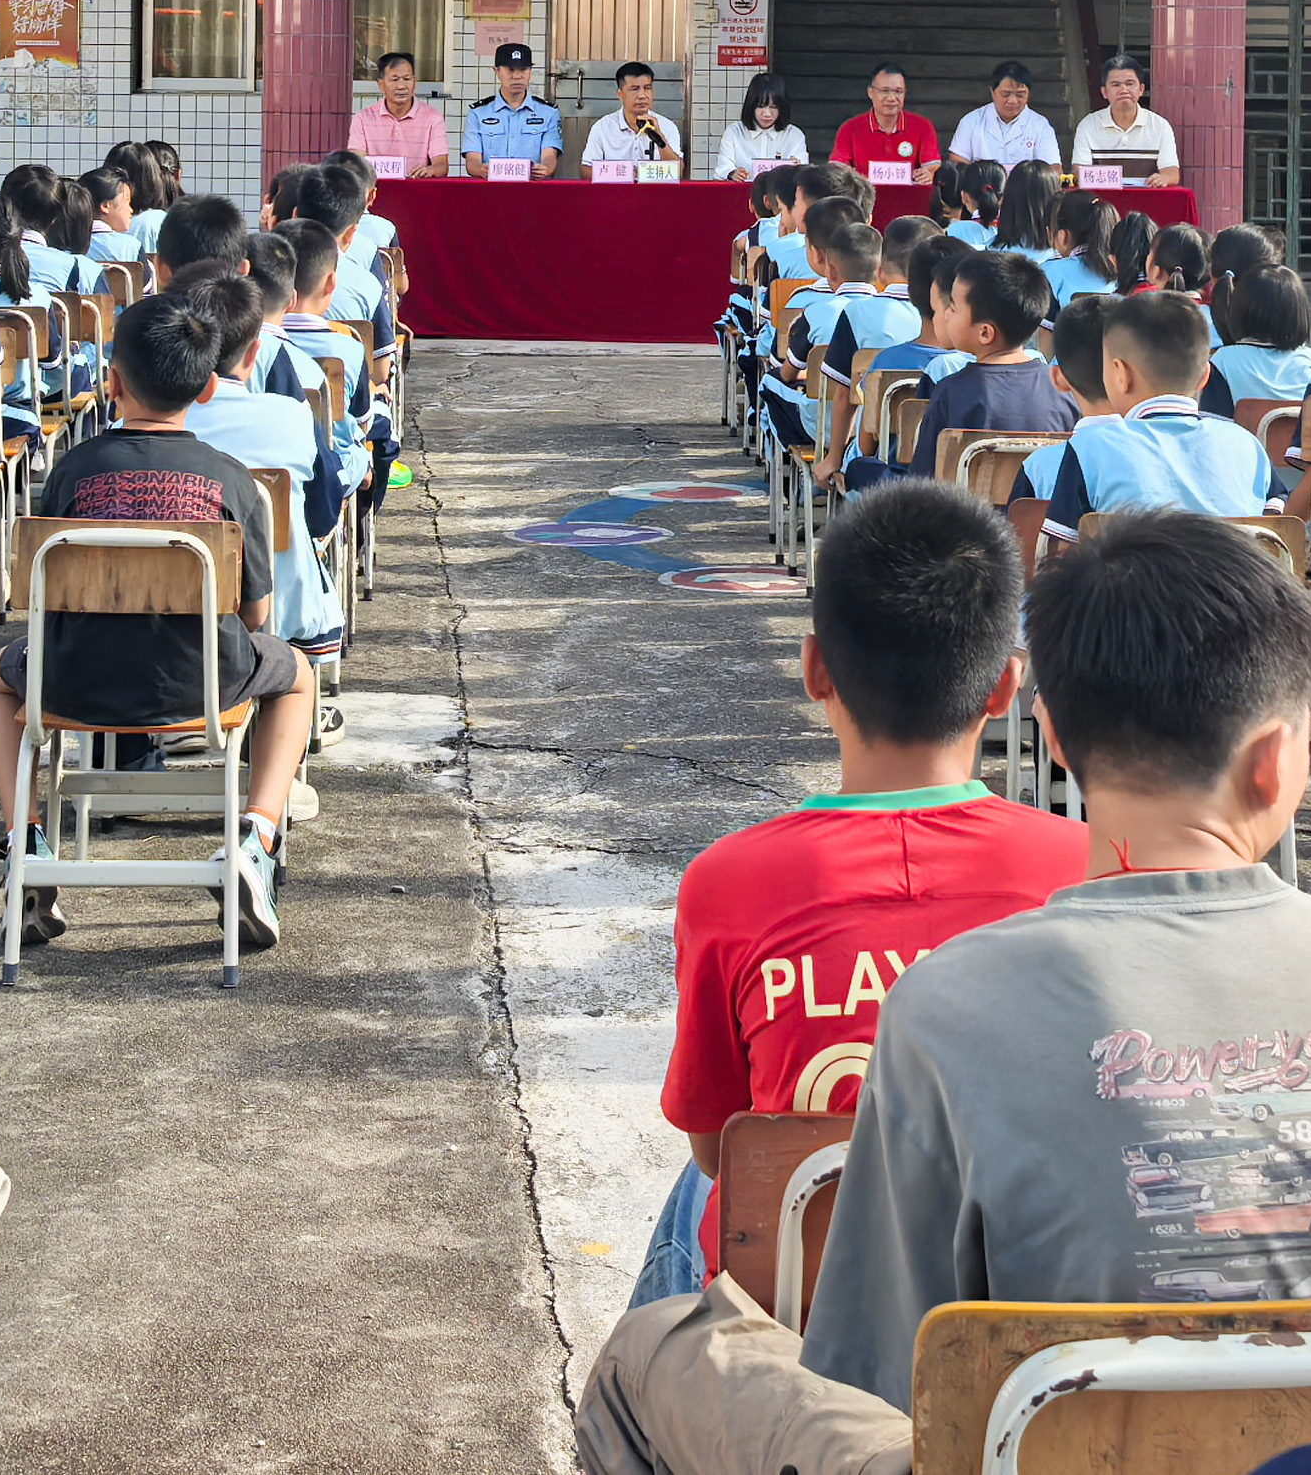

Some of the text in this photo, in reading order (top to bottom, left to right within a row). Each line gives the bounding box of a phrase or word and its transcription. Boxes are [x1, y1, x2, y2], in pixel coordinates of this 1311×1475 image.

[645, 165, 674, 180] 主持人
[74, 470, 224, 493] REASONABLE
